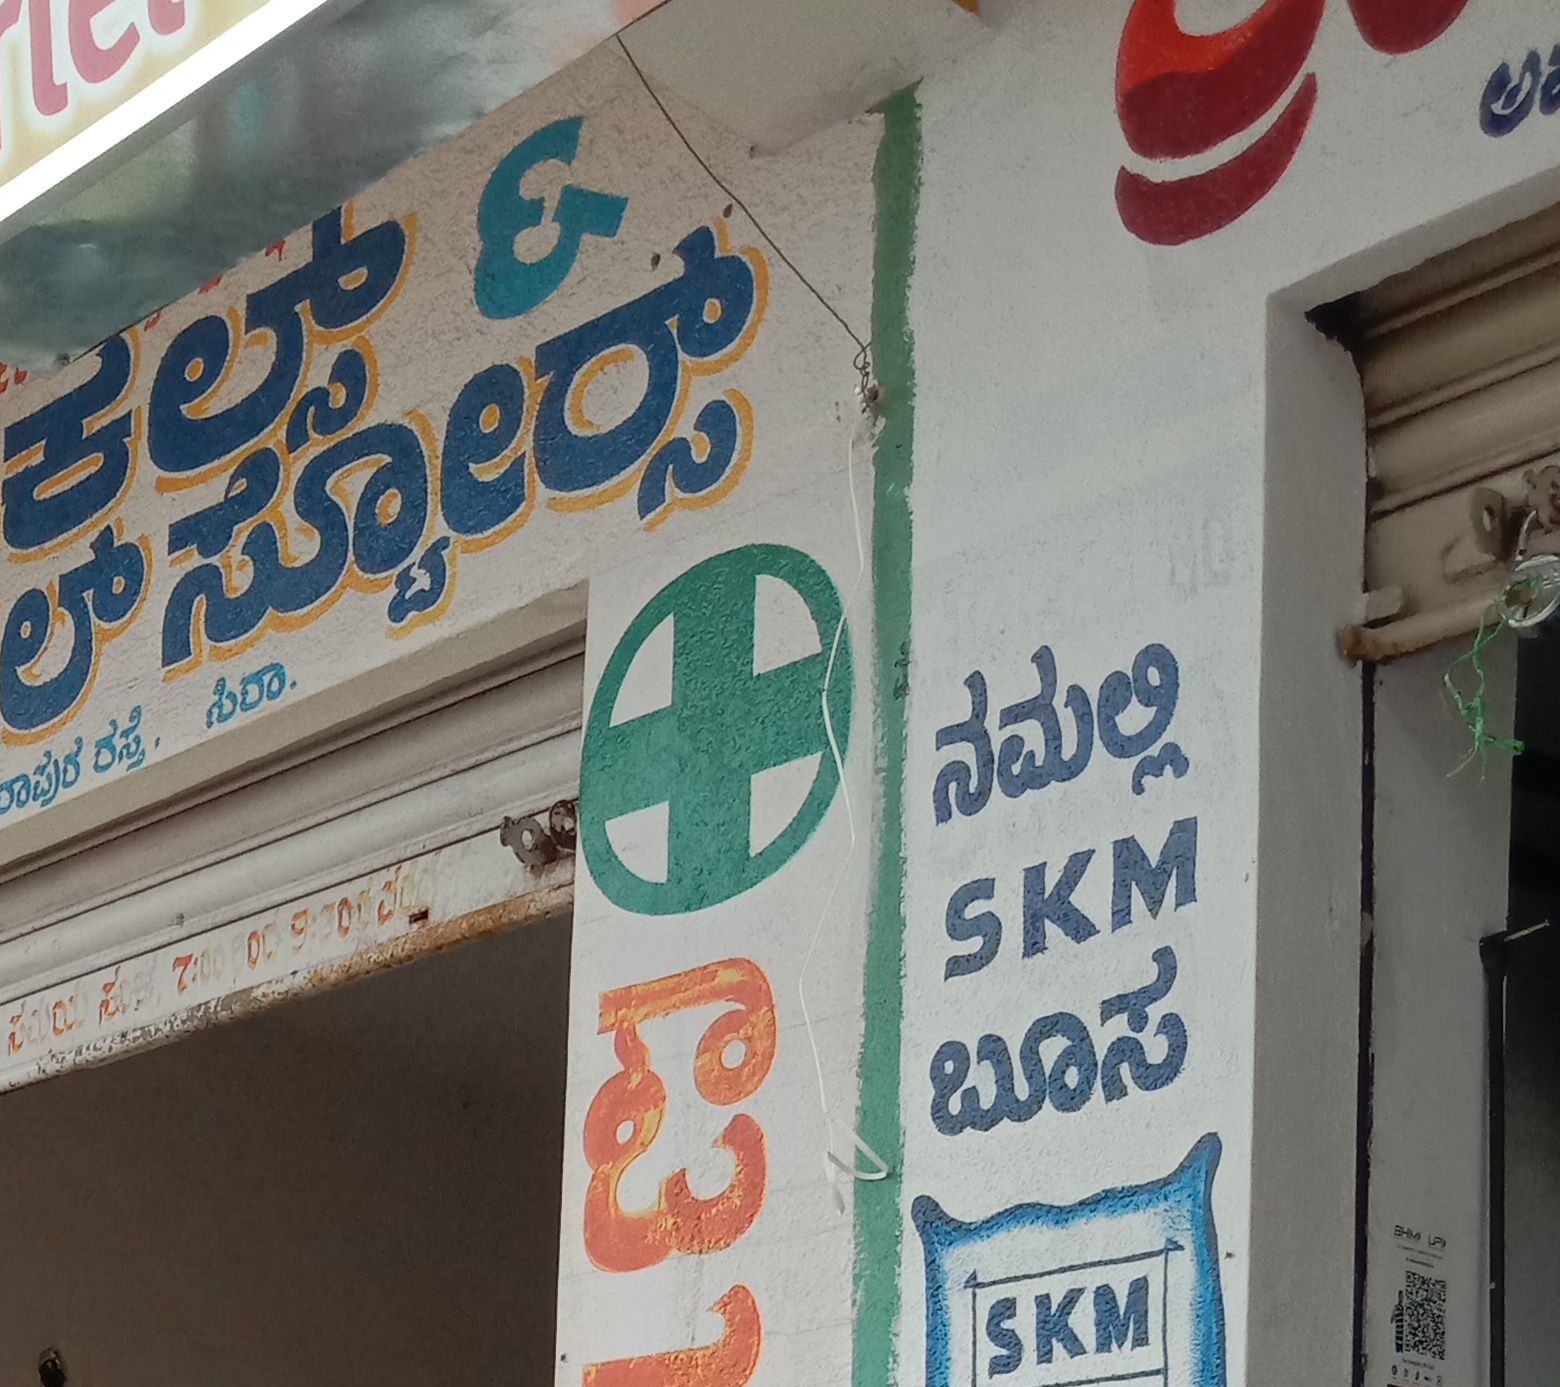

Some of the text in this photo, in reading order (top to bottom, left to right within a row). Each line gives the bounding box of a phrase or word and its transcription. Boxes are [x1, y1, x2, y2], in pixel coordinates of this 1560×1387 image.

[474, 114, 629, 321] &
[944, 816, 1198, 982] SKM
[985, 1275, 1150, 1379] SKM
